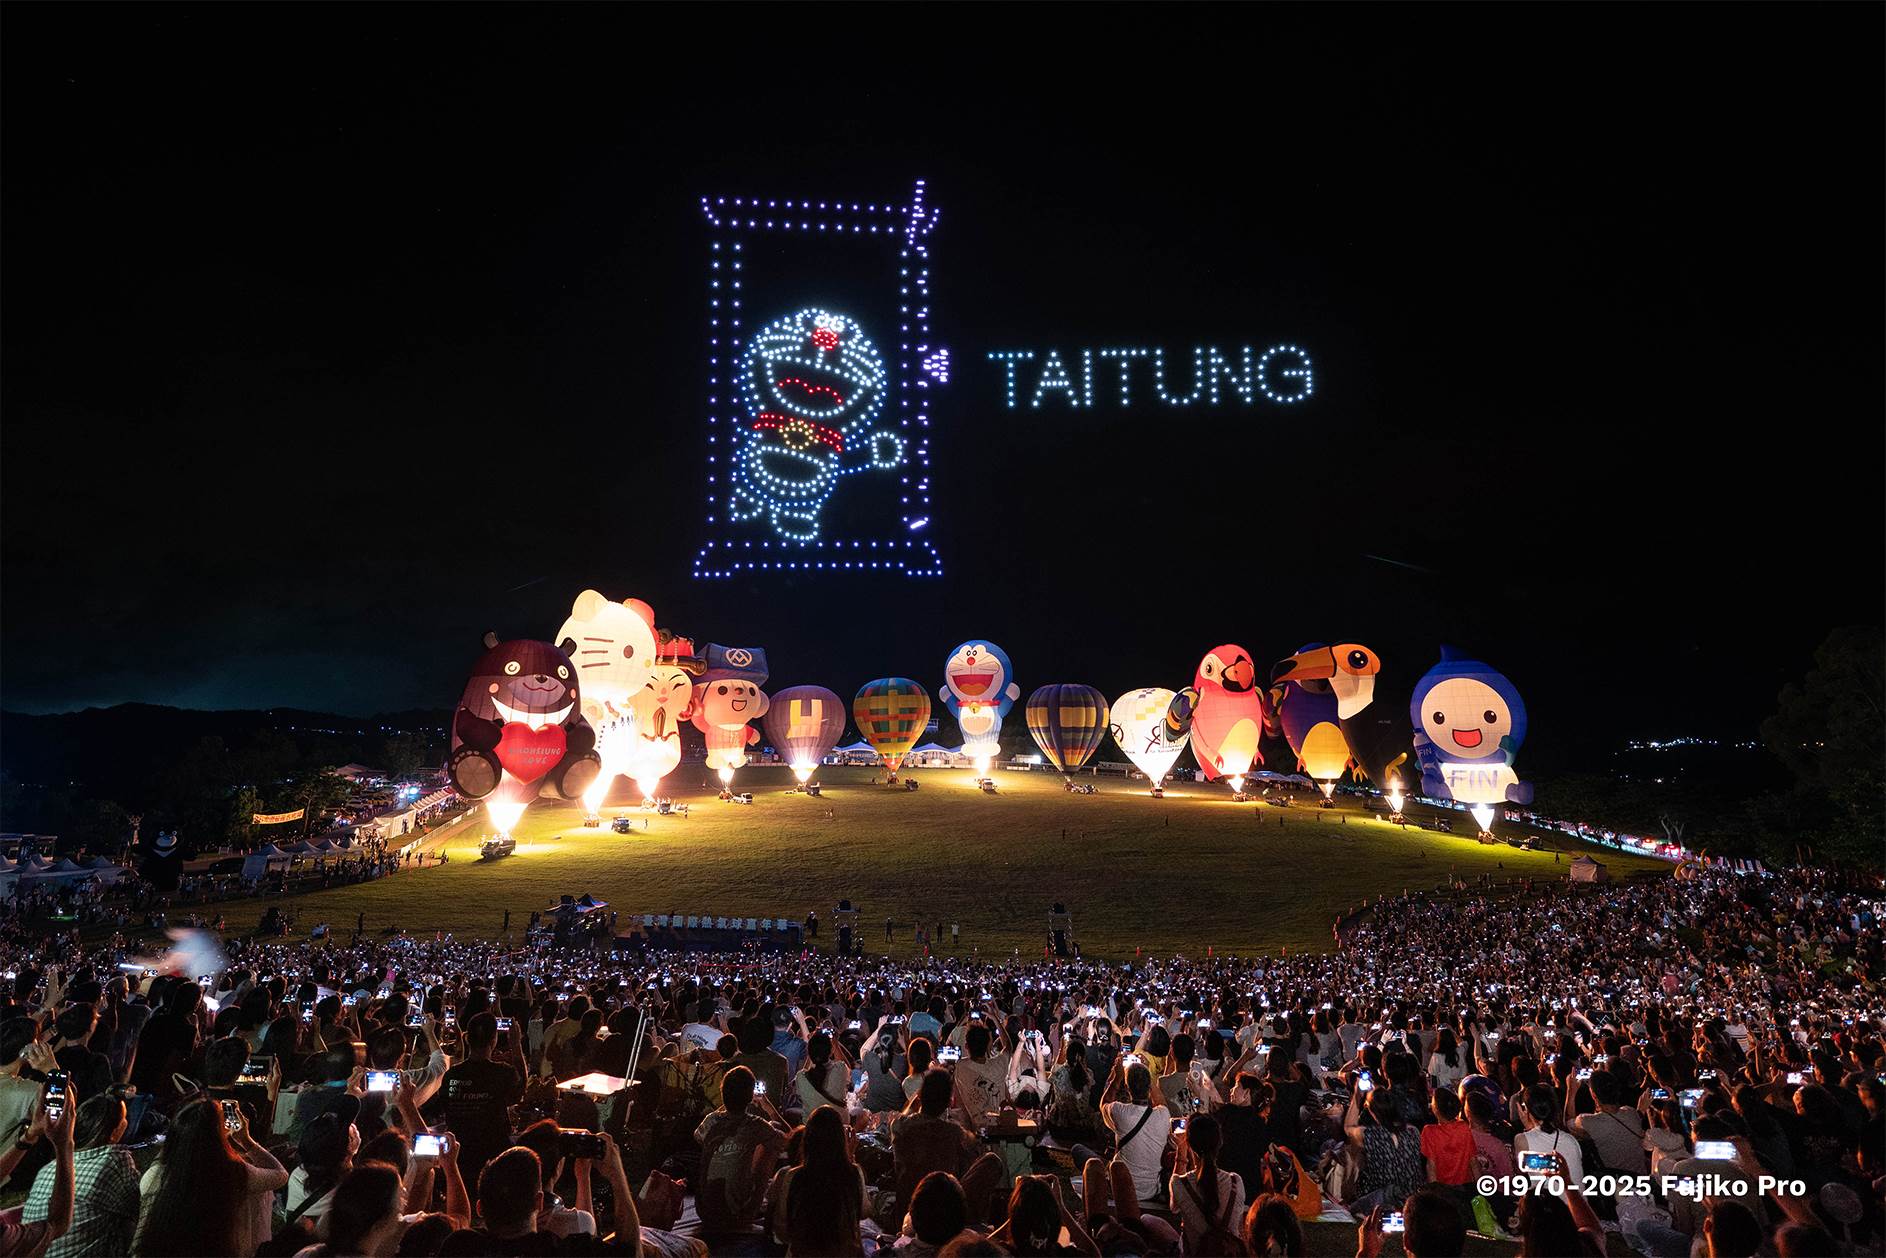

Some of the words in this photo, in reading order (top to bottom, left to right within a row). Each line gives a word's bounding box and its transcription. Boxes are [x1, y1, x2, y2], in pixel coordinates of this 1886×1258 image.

[987, 346, 1312, 405] TAITUNG
[1419, 748, 1432, 756] FIN
[1447, 769, 1498, 788] FIN
